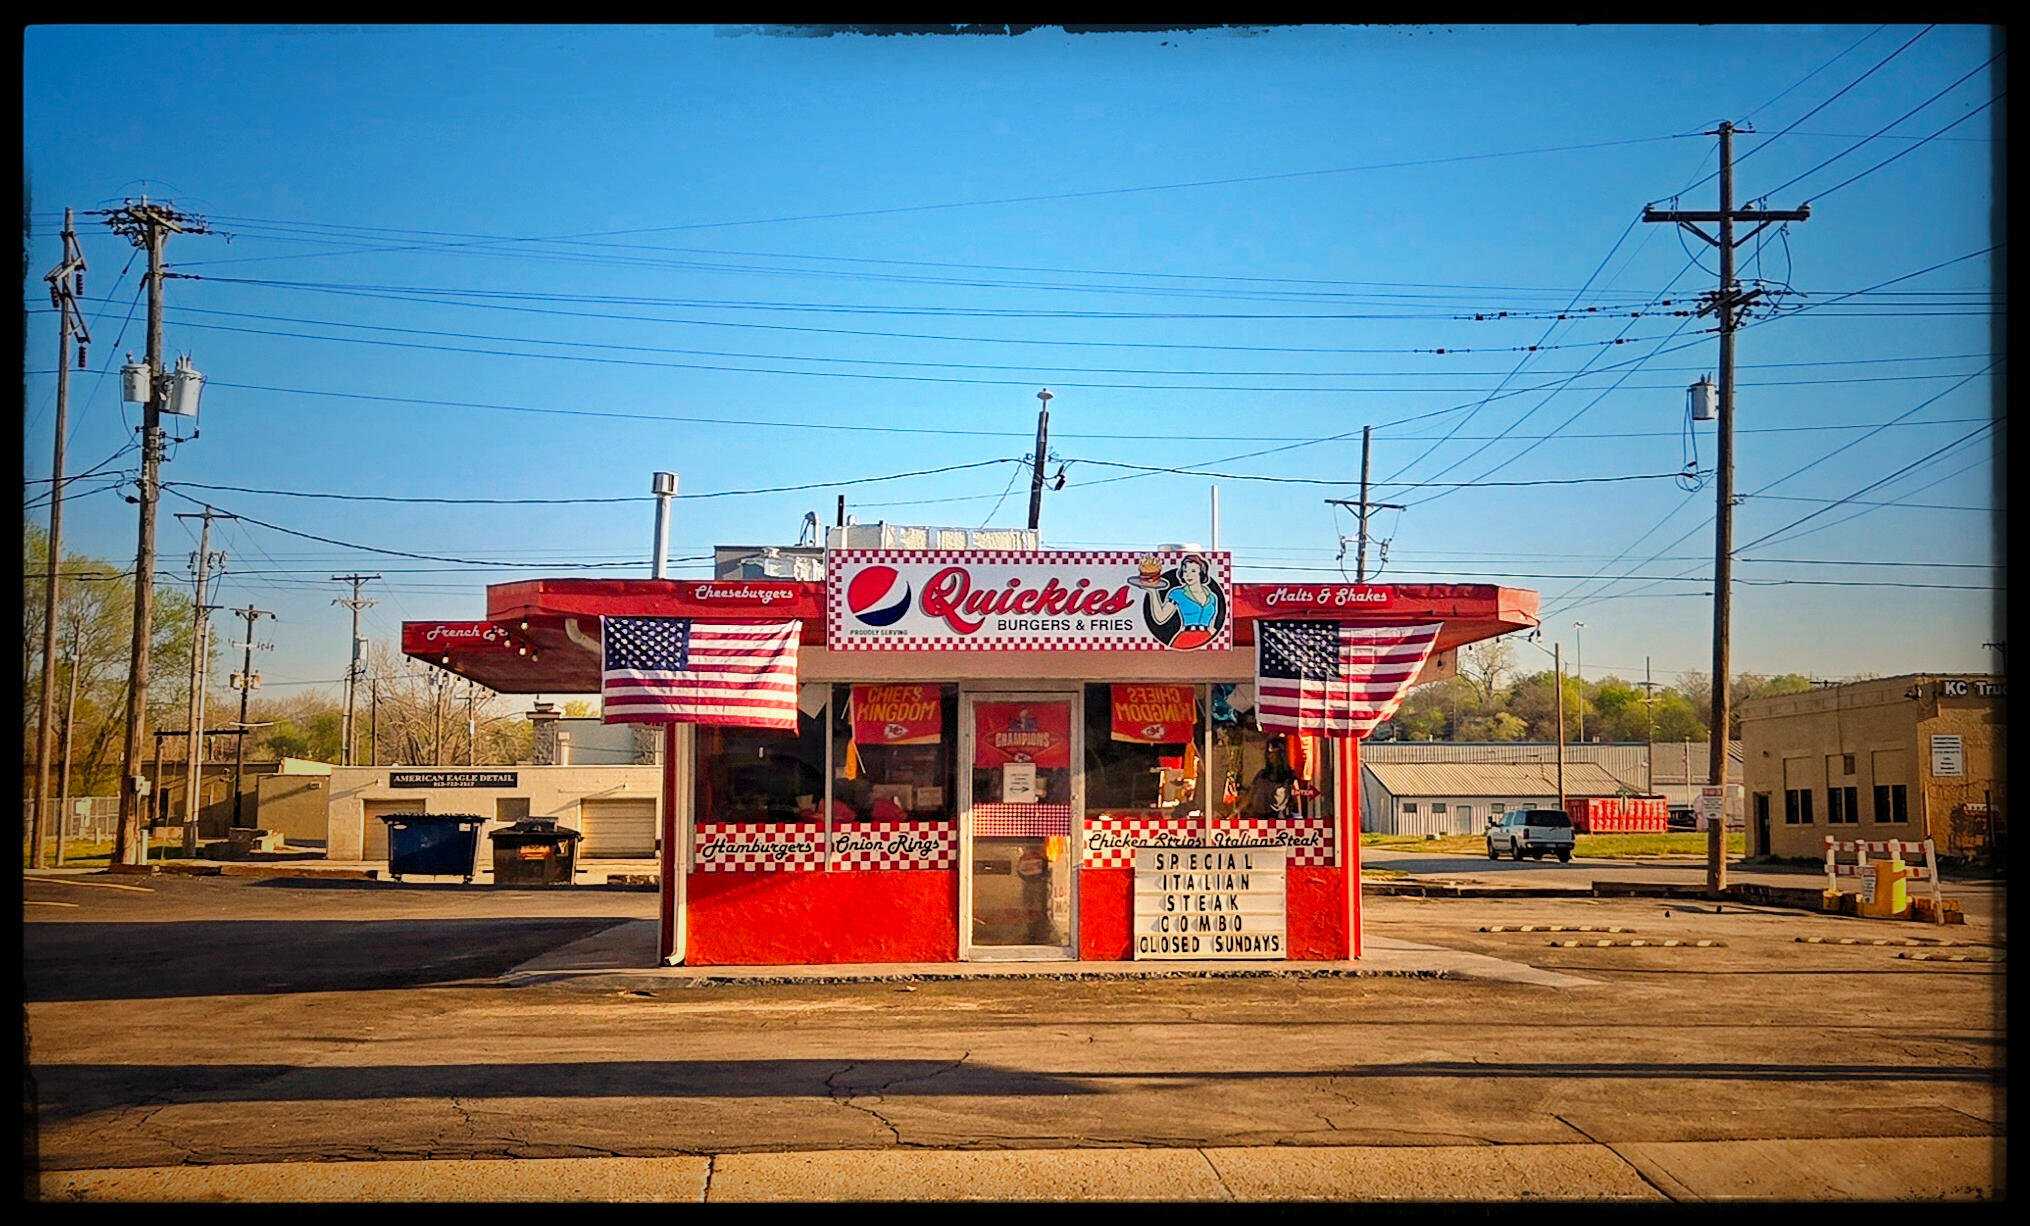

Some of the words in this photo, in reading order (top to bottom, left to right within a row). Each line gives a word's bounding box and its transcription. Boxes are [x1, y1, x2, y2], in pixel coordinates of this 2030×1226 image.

[694, 585, 794, 604] Cheeseburgers
[919, 566, 1135, 634] Quickies
[1266, 588, 1313, 605] Malts
[1317, 588, 1331, 605] &
[1334, 588, 1387, 605] Shakes
[427, 625, 480, 641] French
[997, 619, 1071, 632] BURGERS
[1076, 619, 1086, 632] &
[1090, 619, 1134, 632] FRIES
[868, 686, 924, 703] CHIEFS
[1945, 681, 1968, 695] KC
[857, 701, 937, 721] KINGDOM
[995, 732, 1050, 748] CHAMPIONS
[394, 774, 445, 783] AMERICAN
[446, 774, 478, 782] EAGLE
[480, 774, 514, 782] DETAIL
[836, 836, 883, 854] Onion
[887, 834, 940, 860] Rings
[1089, 833, 1148, 851] Chicken
[1214, 833, 1269, 847] Italian
[1276, 832, 1320, 847] Steak
[702, 837, 812, 860] Hamburgers
[1156, 853, 1253, 870] SPECIAL
[1163, 874, 1249, 891] ITALIAN
[1167, 895, 1239, 911] STEAK
[1161, 915, 1242, 932] COMBO
[1140, 936, 1200, 953] CLOSED
[1215, 935, 1279, 952] SUNDAYS
